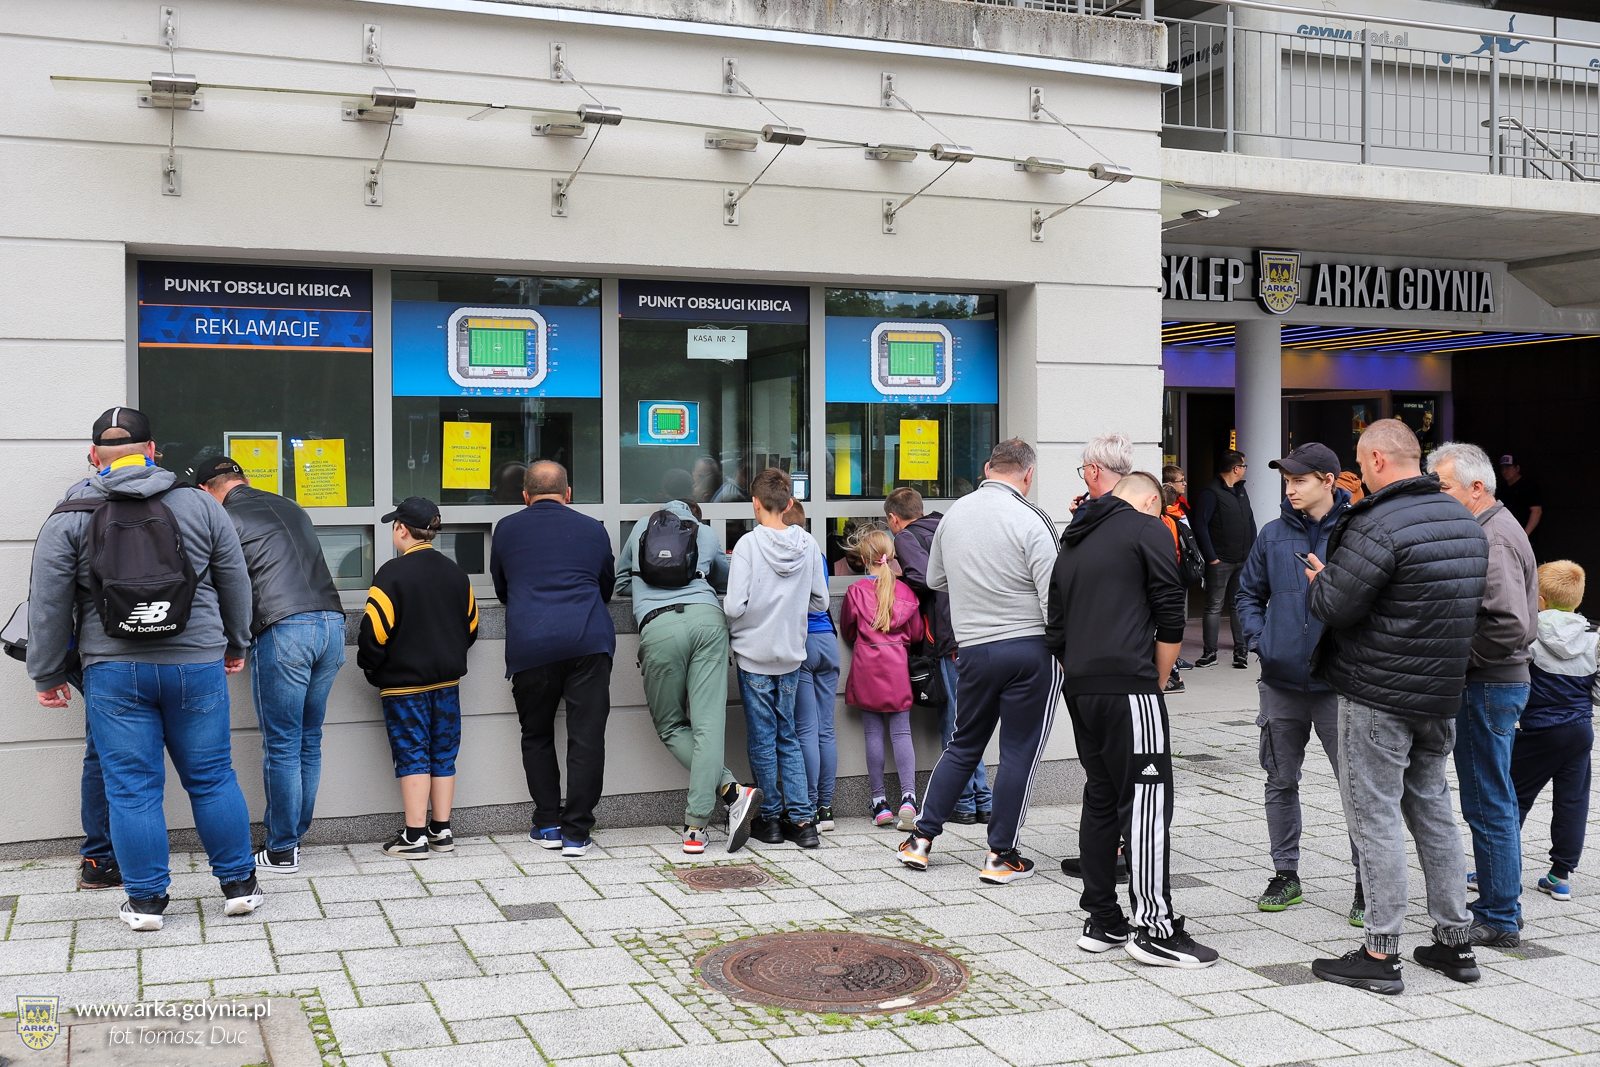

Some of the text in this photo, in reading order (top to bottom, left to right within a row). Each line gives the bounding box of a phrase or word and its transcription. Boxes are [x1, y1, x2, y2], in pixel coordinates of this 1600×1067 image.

[164, 278, 352, 298] PUNKT OBSŁUGI KIBICA
[1266, 284, 1294, 292] ARKA
[1315, 263, 1494, 312] ARKA GDYNIA
[638, 295, 792, 312] PUNKT OBSŁUGI KIBICA
[195, 318, 320, 338] REKLAMACJE
[693, 334, 713, 342] KASA
[716, 335, 726, 343] NR
[118, 622, 177, 632] new balance
